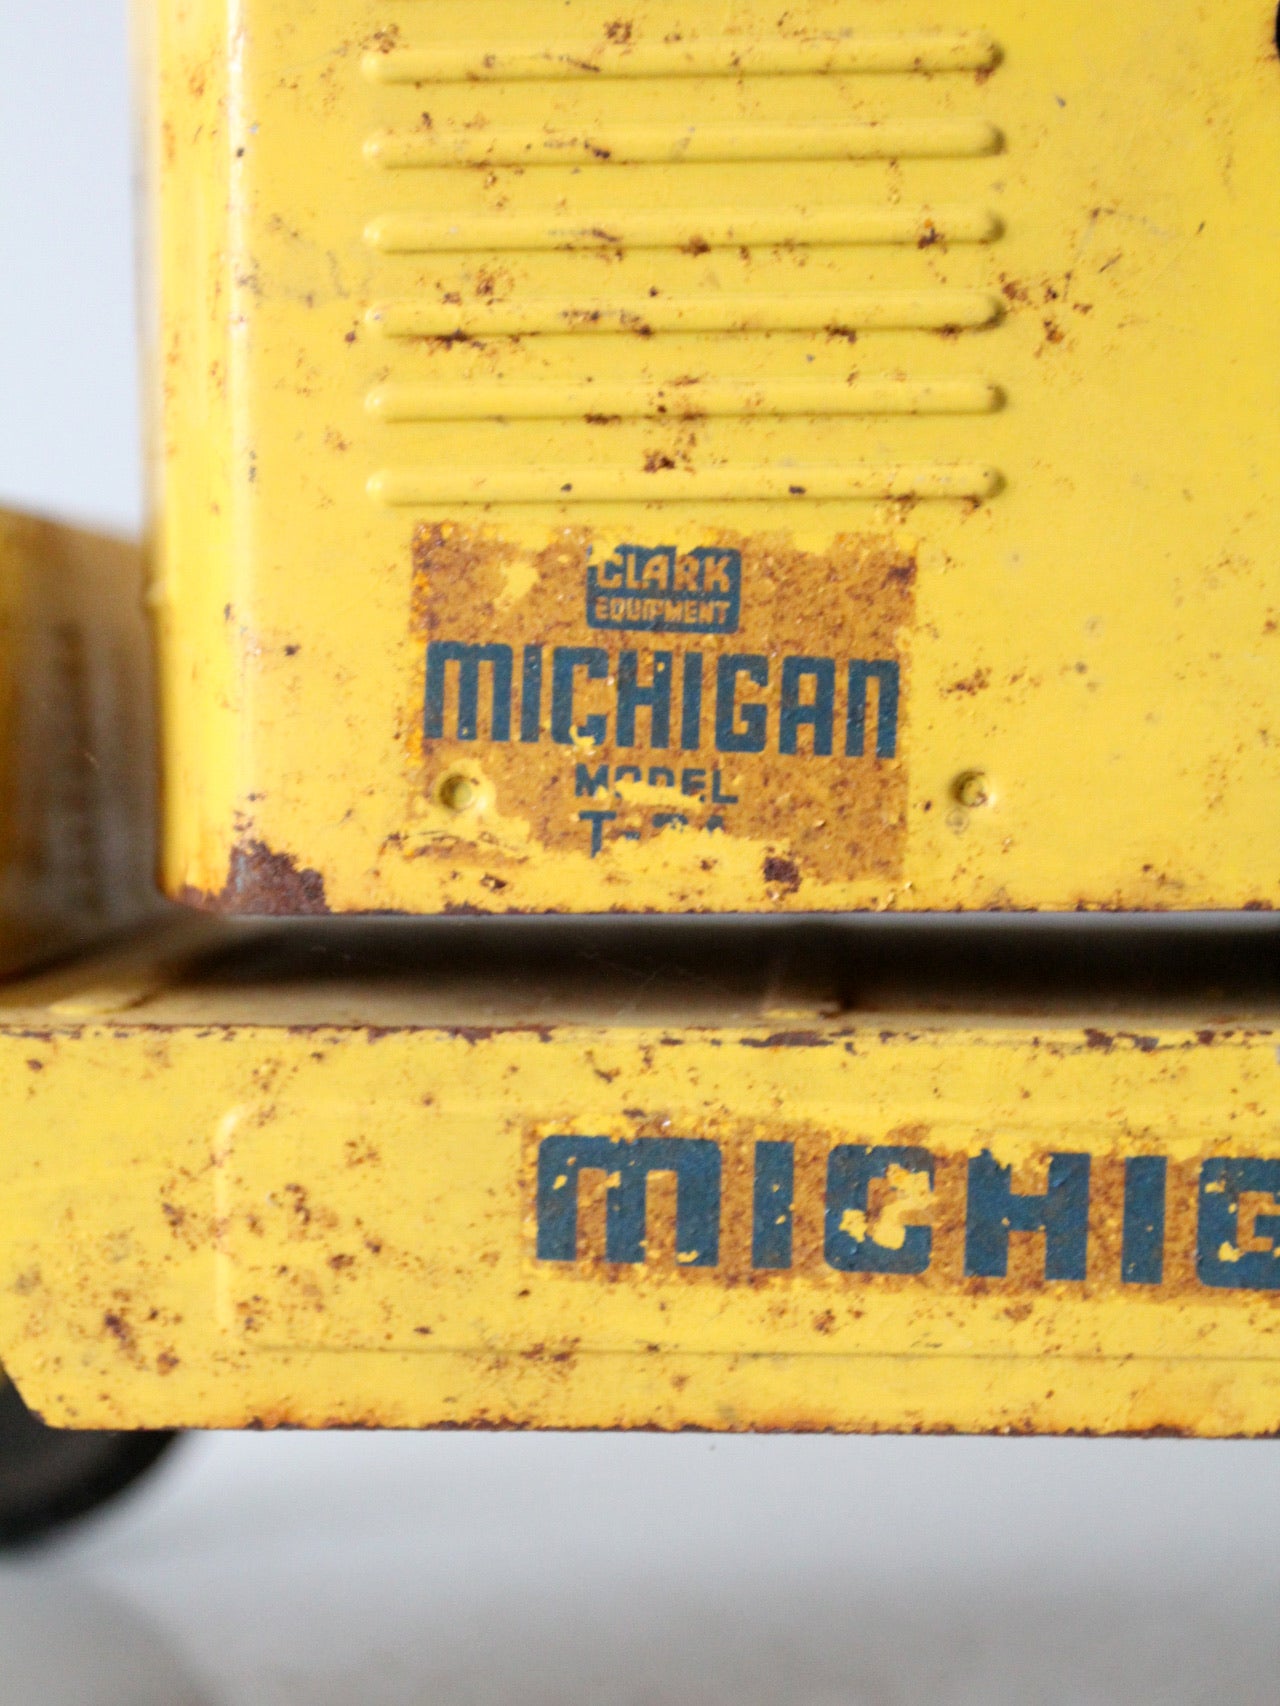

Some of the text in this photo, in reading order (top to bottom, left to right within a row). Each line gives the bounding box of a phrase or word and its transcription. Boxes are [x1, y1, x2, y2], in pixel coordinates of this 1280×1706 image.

[595, 597, 731, 625] EQUIPMENT
[597, 553, 731, 593] CLARK
[424, 641, 900, 758] MICHIGAN
[536, 1134, 1280, 1290] MICHIG
